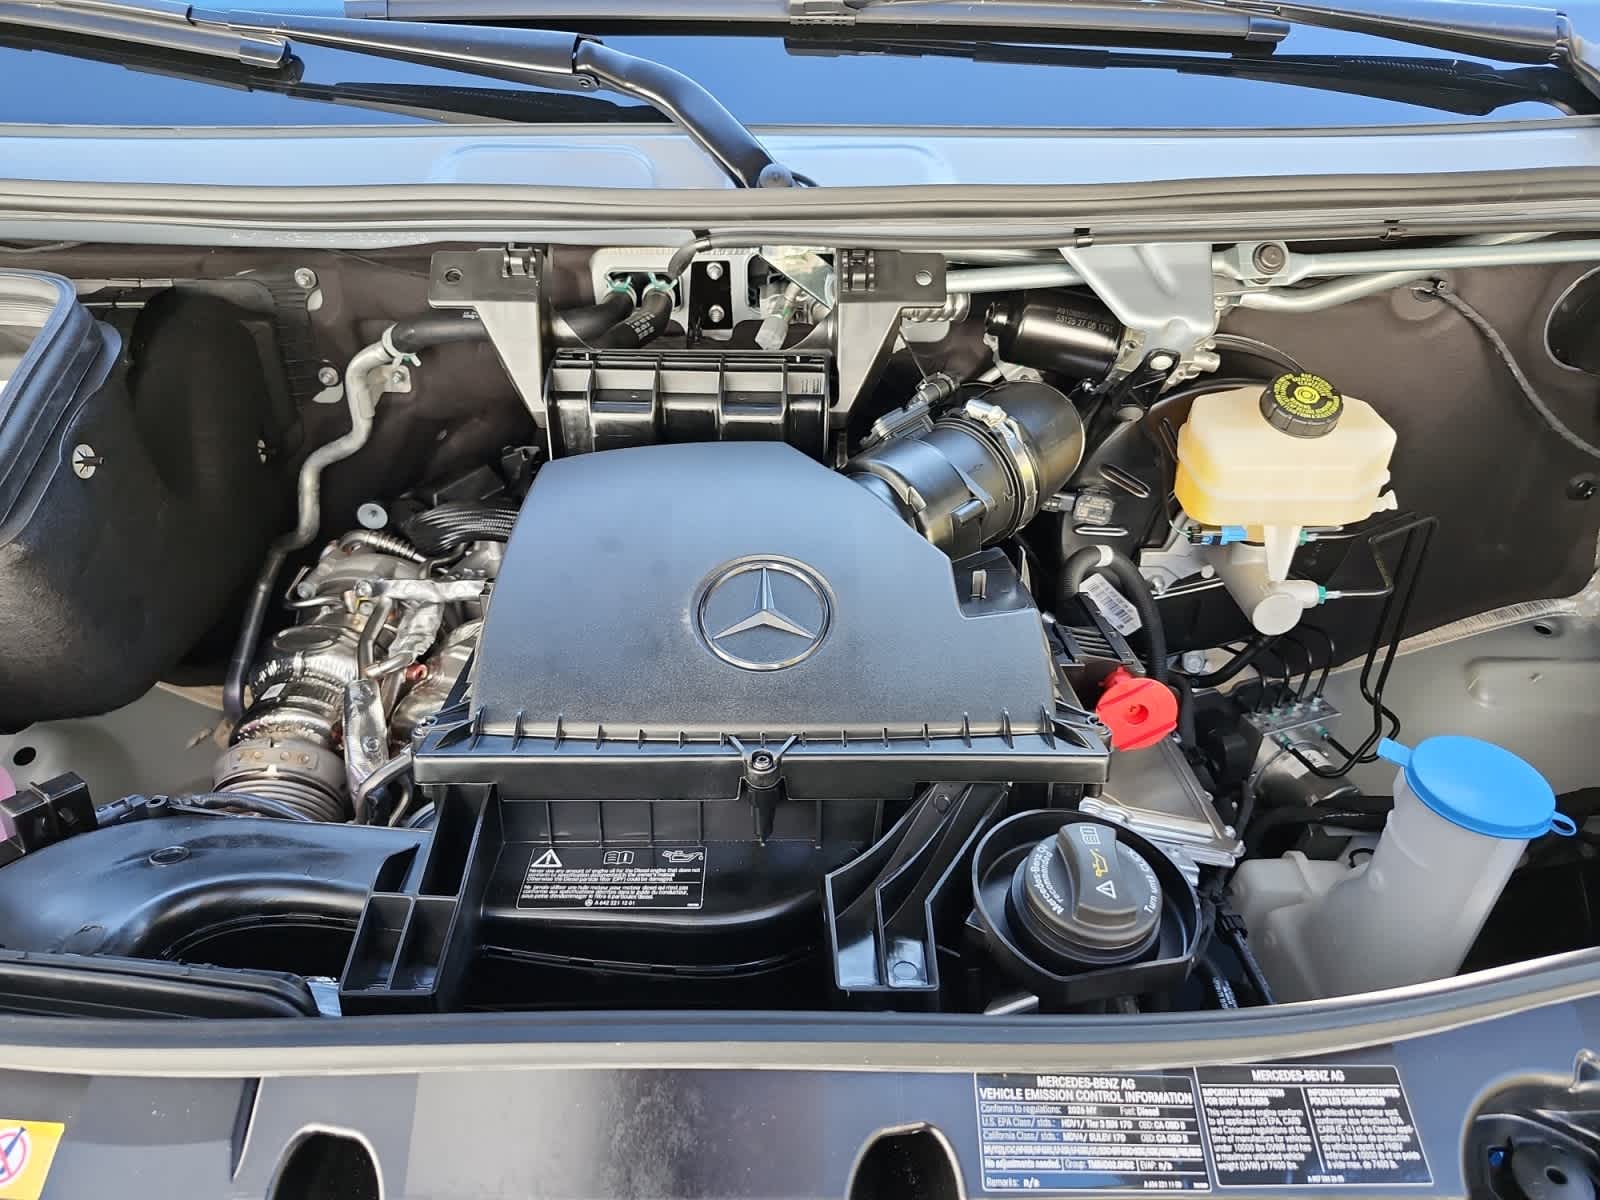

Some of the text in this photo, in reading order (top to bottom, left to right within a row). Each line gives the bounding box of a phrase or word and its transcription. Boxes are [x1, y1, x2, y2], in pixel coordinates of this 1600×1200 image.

[1031, 854, 1064, 915] Mercedes-Benz
[1144, 895, 1158, 913] Turn
[1036, 1075, 1136, 1090] MERCEDES-BENZ AG
[1251, 1070, 1346, 1082] MERCEDES-BENZ AG
[979, 1087, 1193, 1104] VEHICLE EMISSION CONTROL INFORMATION
